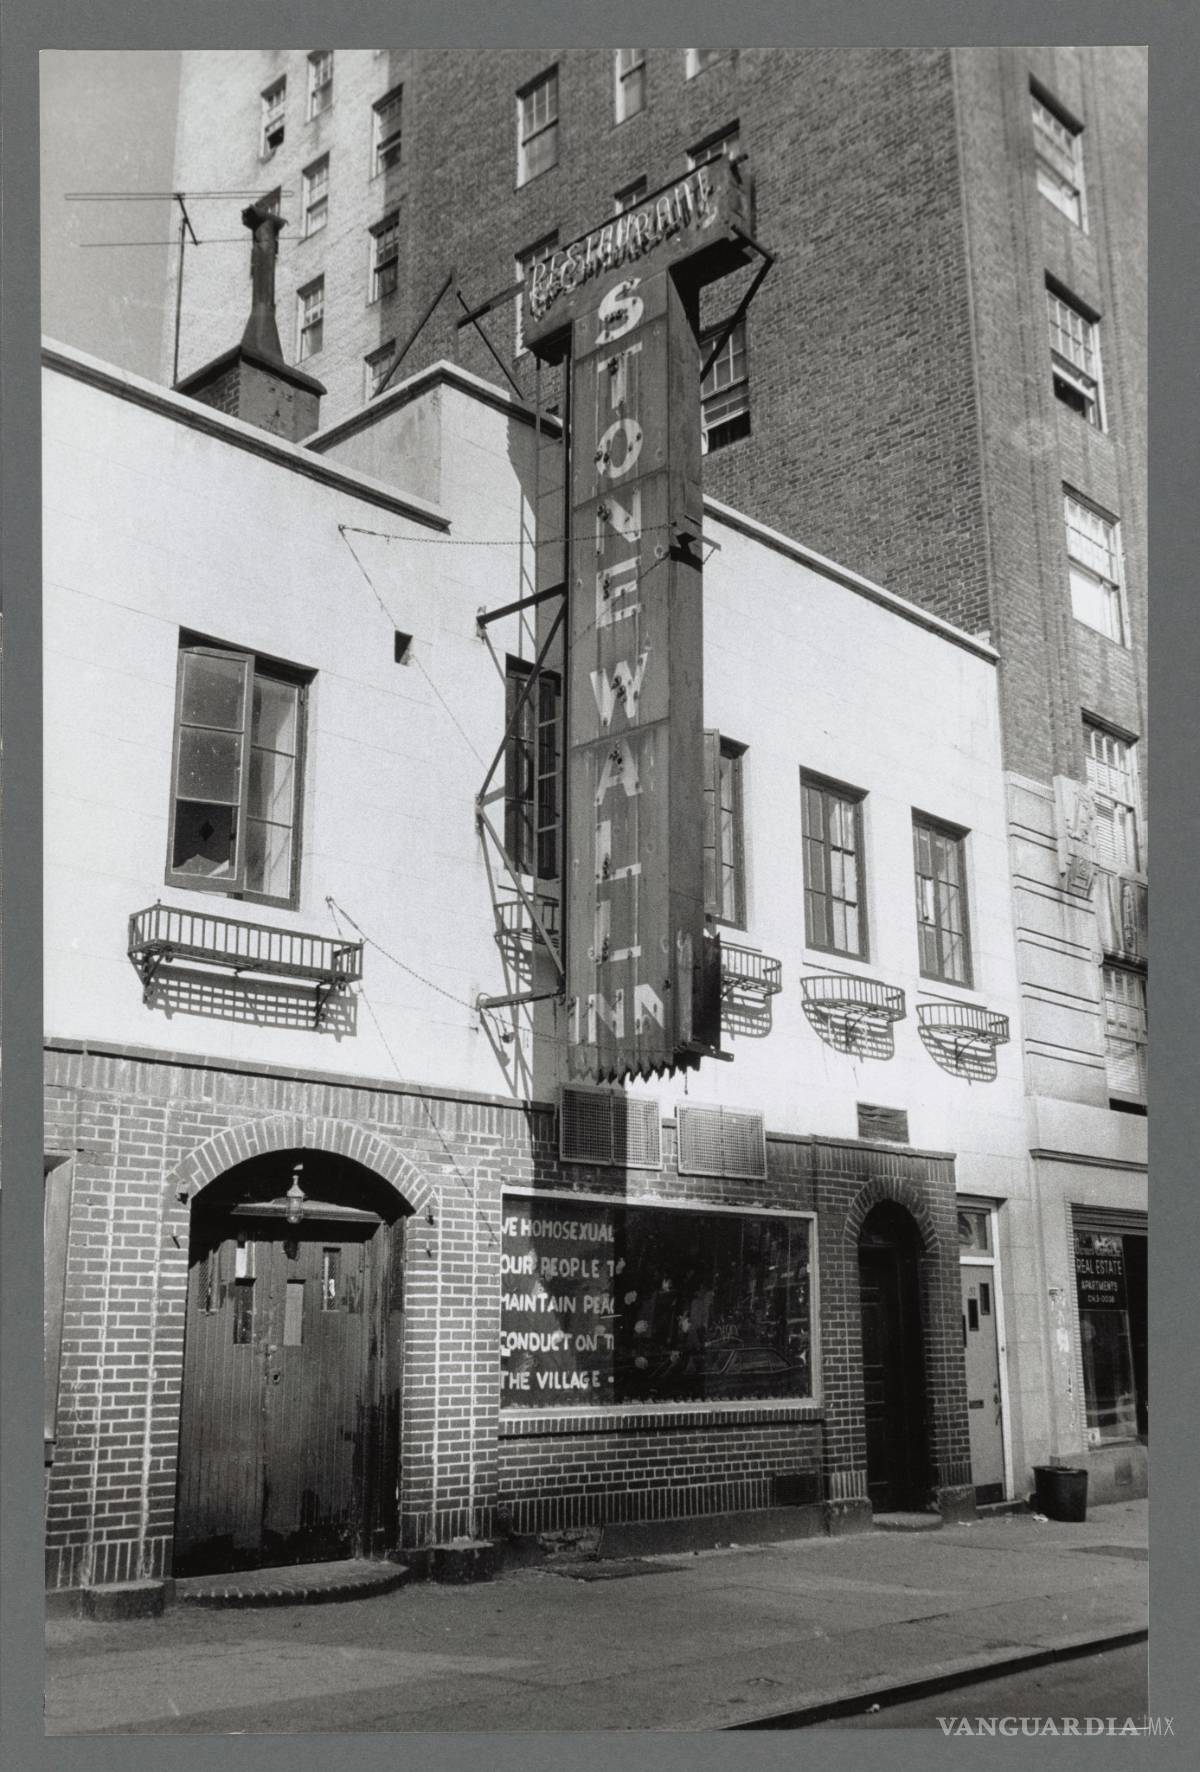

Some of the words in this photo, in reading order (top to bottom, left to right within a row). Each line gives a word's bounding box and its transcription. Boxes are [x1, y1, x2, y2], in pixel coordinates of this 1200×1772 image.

[590, 277, 649, 965] STONEWALL
[570, 984, 664, 1045] INN
[521, 1218, 615, 1243] HOMOSEXUAL
[500, 1254, 534, 1275] OUR
[541, 1256, 600, 1278] PEOPLE
[1076, 1258, 1095, 1274] REAL
[1096, 1259, 1123, 1275] ESTATE
[500, 1293, 577, 1313] MAINTAIN
[500, 1331, 573, 1352] CONDUCT
[575, 1334, 598, 1351] ON
[500, 1370, 531, 1390] THE
[537, 1371, 601, 1390] VILLAGE
